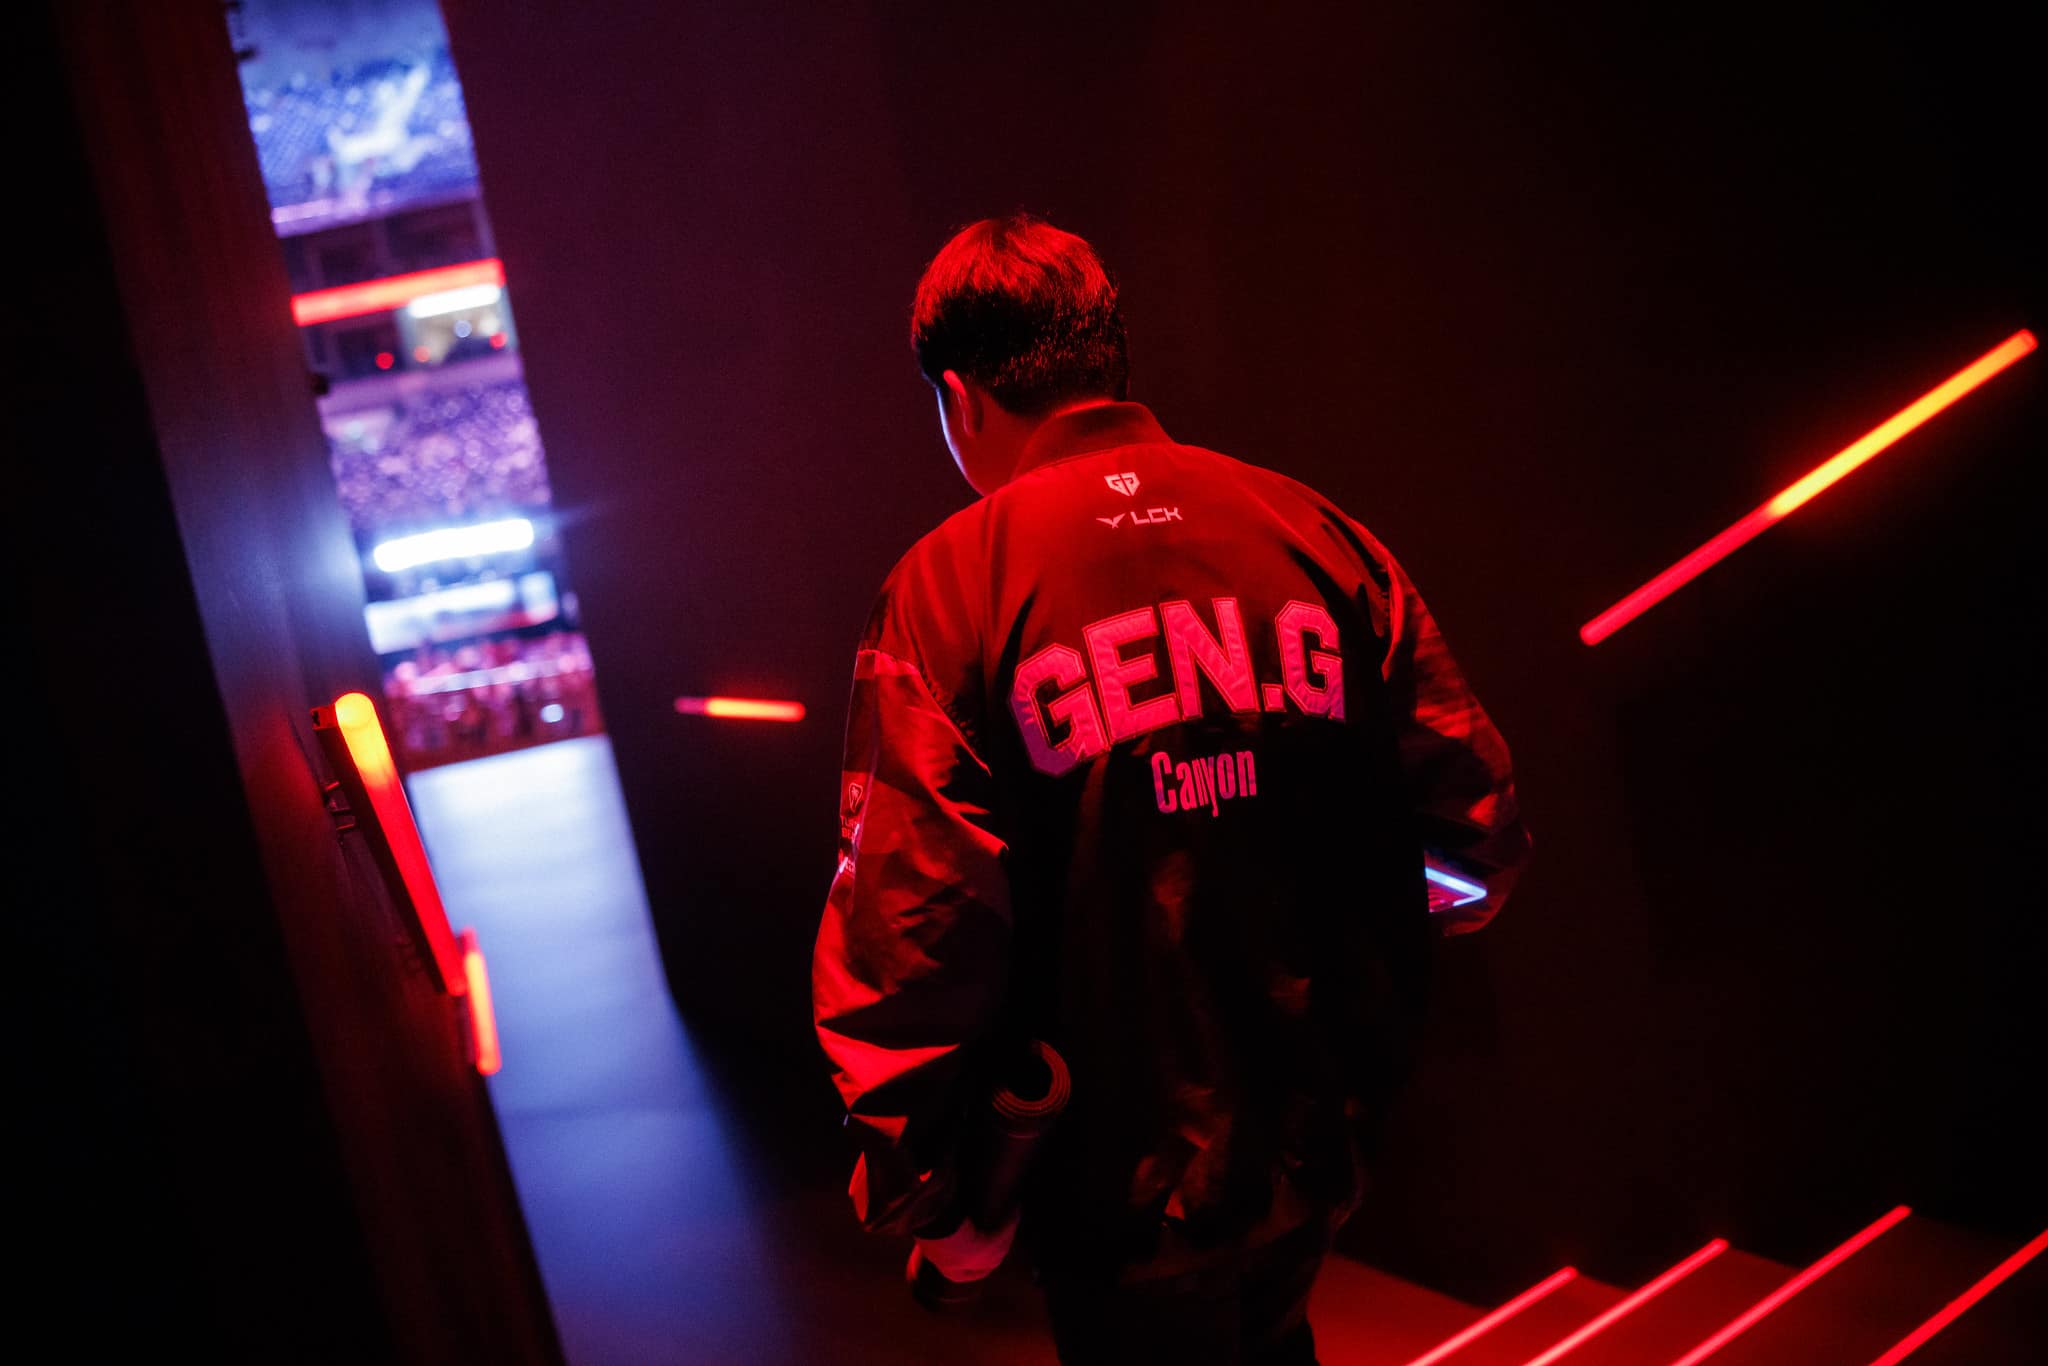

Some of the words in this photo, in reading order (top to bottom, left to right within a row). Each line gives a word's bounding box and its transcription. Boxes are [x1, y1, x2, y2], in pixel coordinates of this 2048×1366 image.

[1130, 507, 1183, 525] LCK
[1010, 597, 1345, 778] GEN.G
[1151, 750, 1257, 816] Canyon
